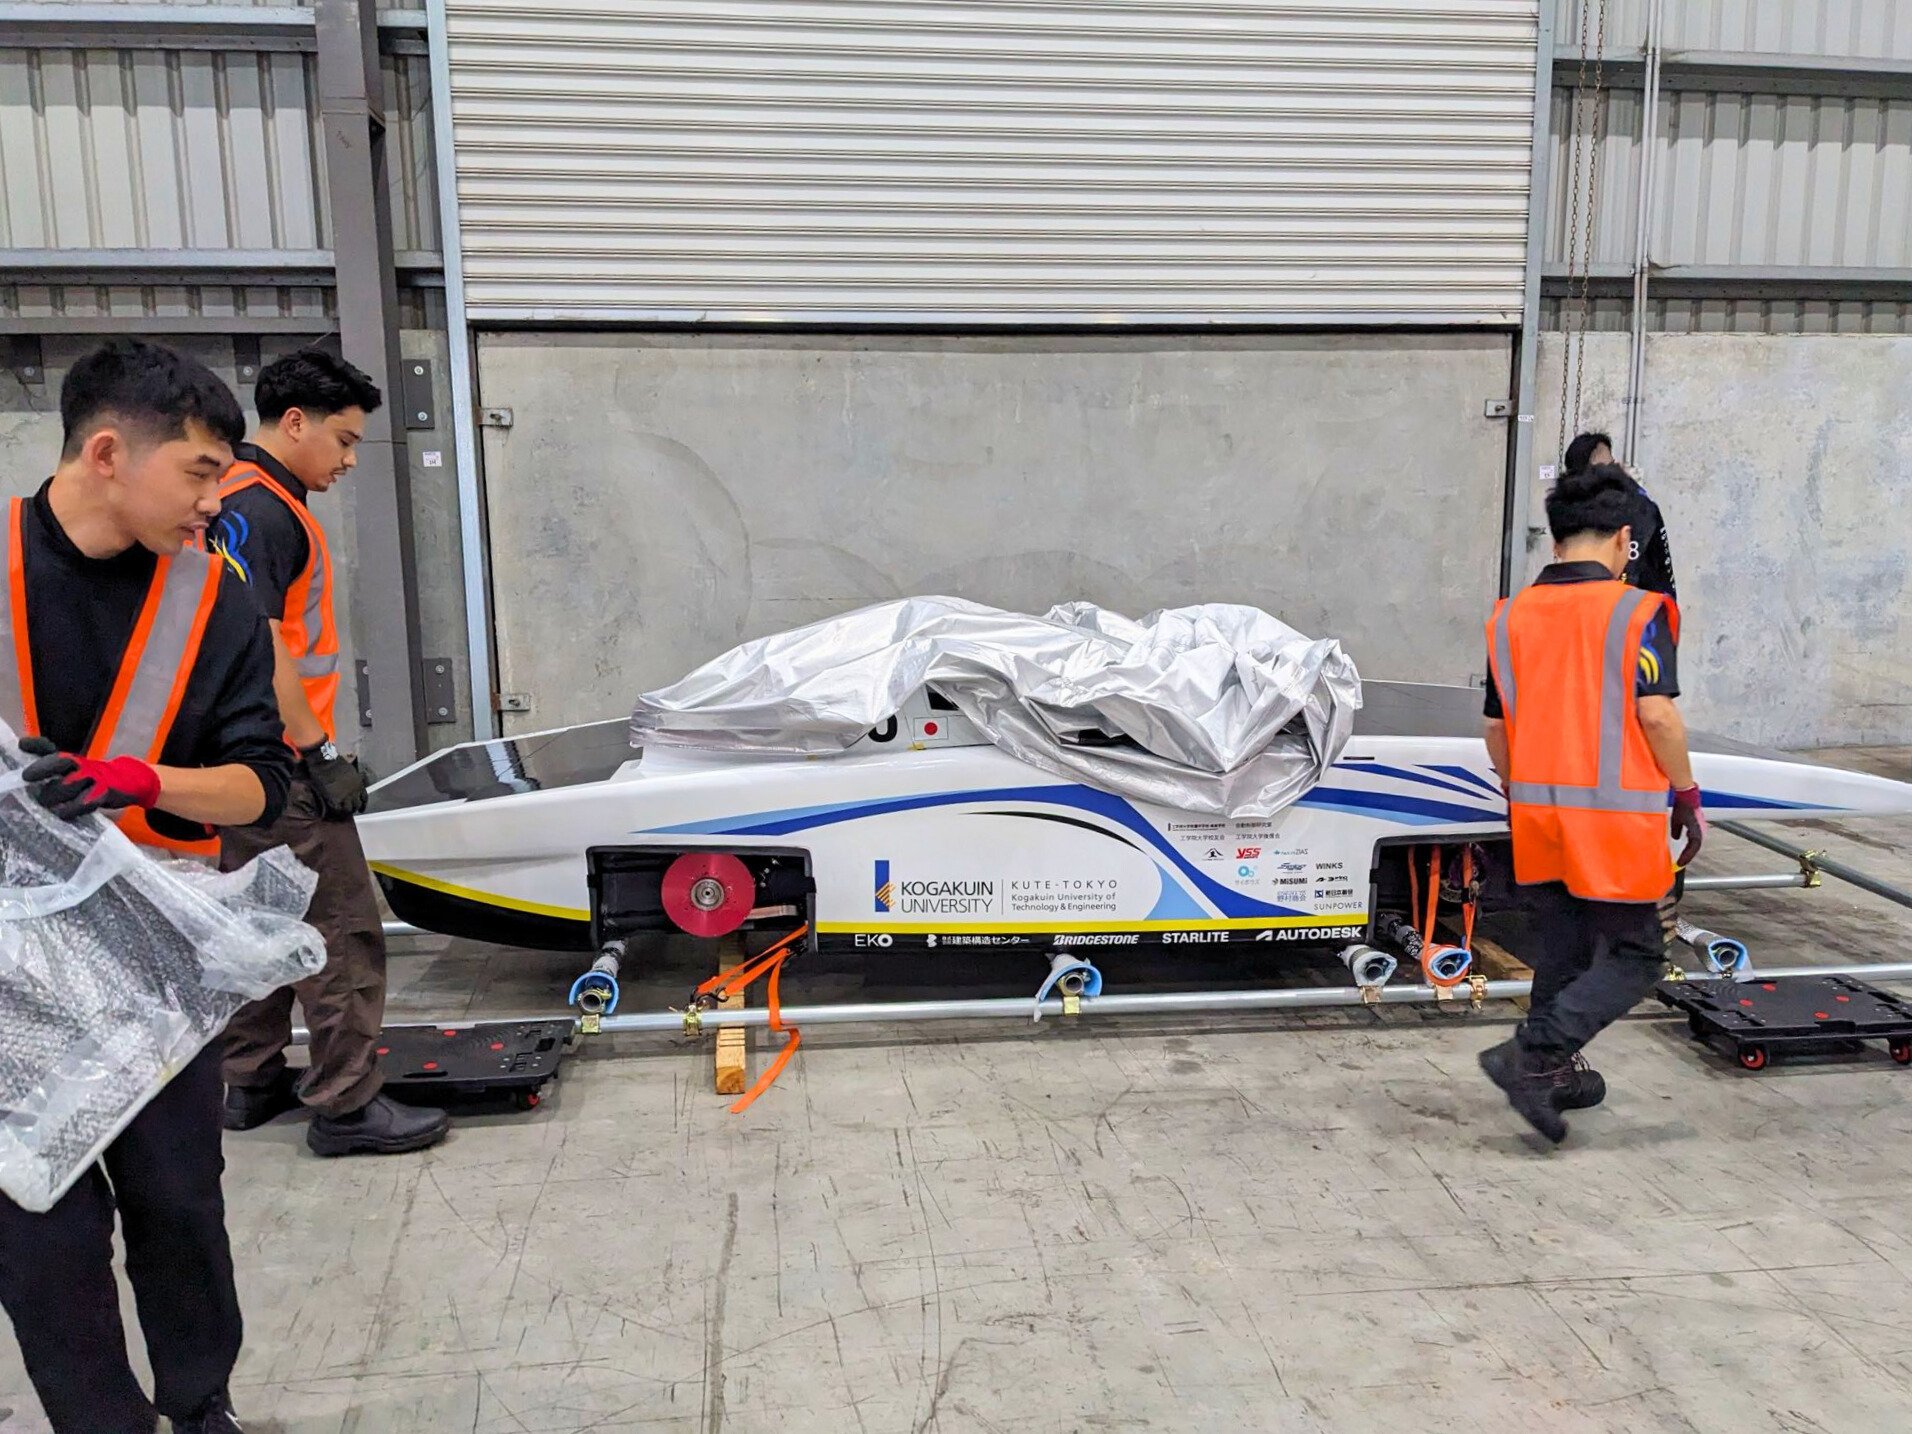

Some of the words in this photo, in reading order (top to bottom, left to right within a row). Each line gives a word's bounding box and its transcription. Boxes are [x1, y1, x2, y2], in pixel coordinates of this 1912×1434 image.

[1628, 541, 1640, 560] 8
[1316, 862, 1343, 870] WINKS
[901, 881, 994, 896] KOGAKUIN
[1011, 893, 1055, 903] Kogakuin
[1057, 892, 1104, 902] University
[1106, 892, 1117, 901] of
[901, 898, 993, 914] UNIVERSITY
[1012, 903, 1059, 912] Technology
[1060, 903, 1067, 911] &
[1068, 902, 1117, 912] Engineering
[1314, 902, 1363, 911] SUNPOWER
[1053, 934, 1140, 945] BRIDGESTONE
[1162, 932, 1230, 944] STARLITE
[1276, 926, 1362, 941] AUTODESK
[854, 933, 893, 947] EKO
